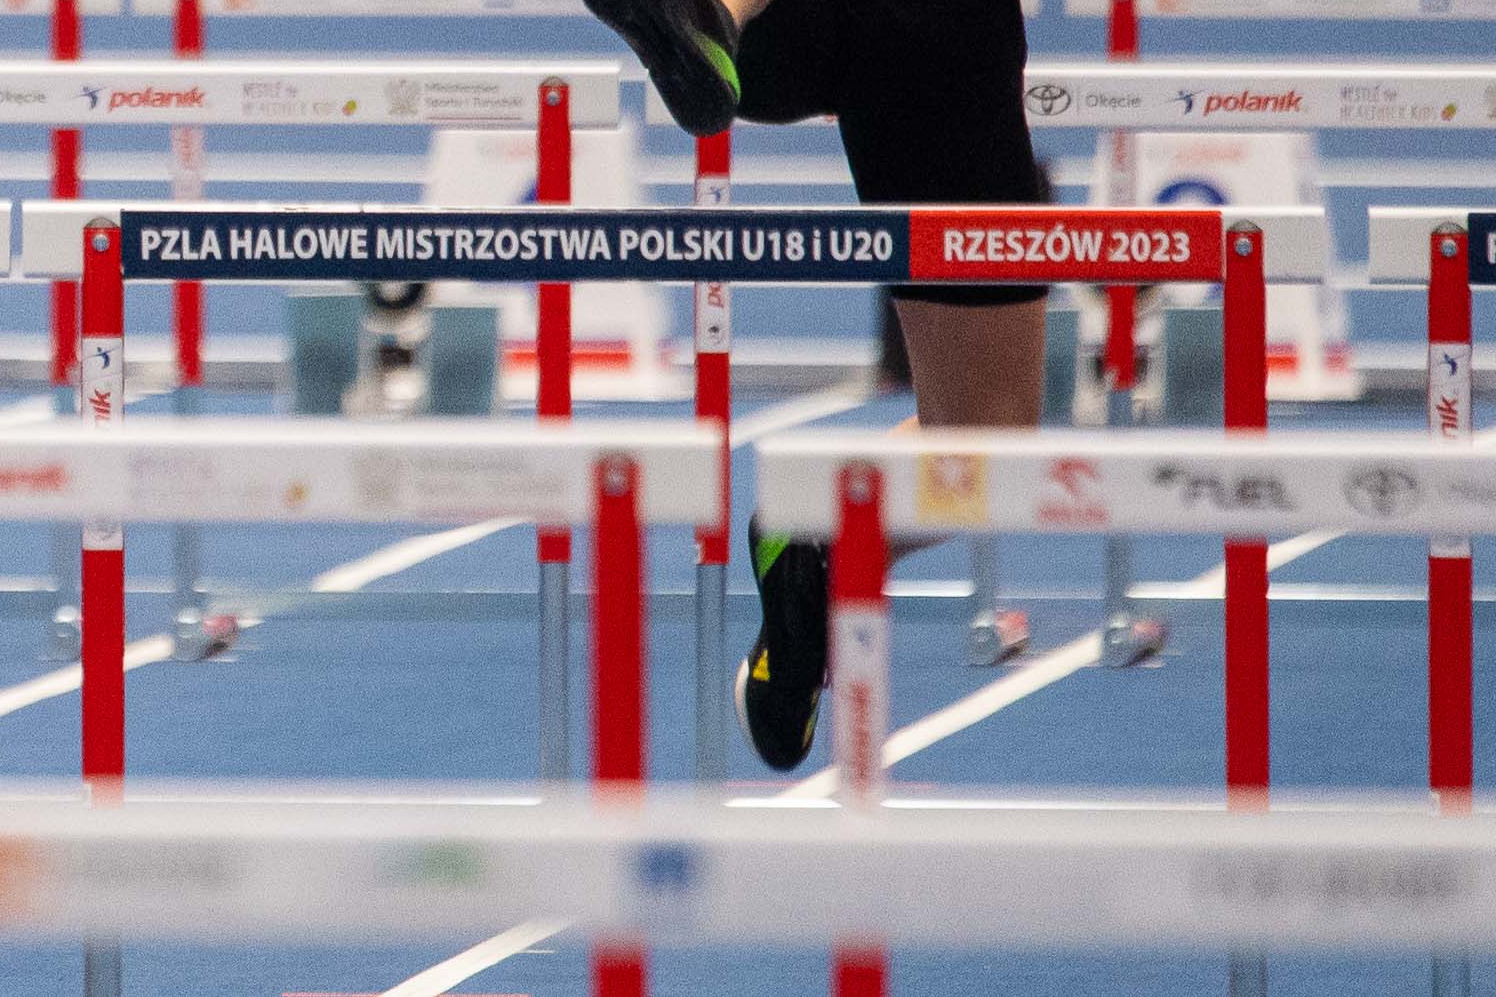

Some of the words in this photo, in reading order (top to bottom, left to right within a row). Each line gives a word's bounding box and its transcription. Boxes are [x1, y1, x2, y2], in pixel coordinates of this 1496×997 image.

[107, 86, 205, 112] polanik
[1203, 89, 1303, 116] polanik
[141, 228, 222, 261] PZLA
[229, 227, 368, 260] HALOWE
[376, 227, 612, 260] MISTRZOSTWA
[619, 228, 733, 261] POLSKI
[742, 229, 805, 261] U18
[812, 229, 821, 261] i
[830, 229, 893, 261] U20
[943, 224, 1103, 262] RZESZÓW
[1108, 231, 1190, 263] 2023
